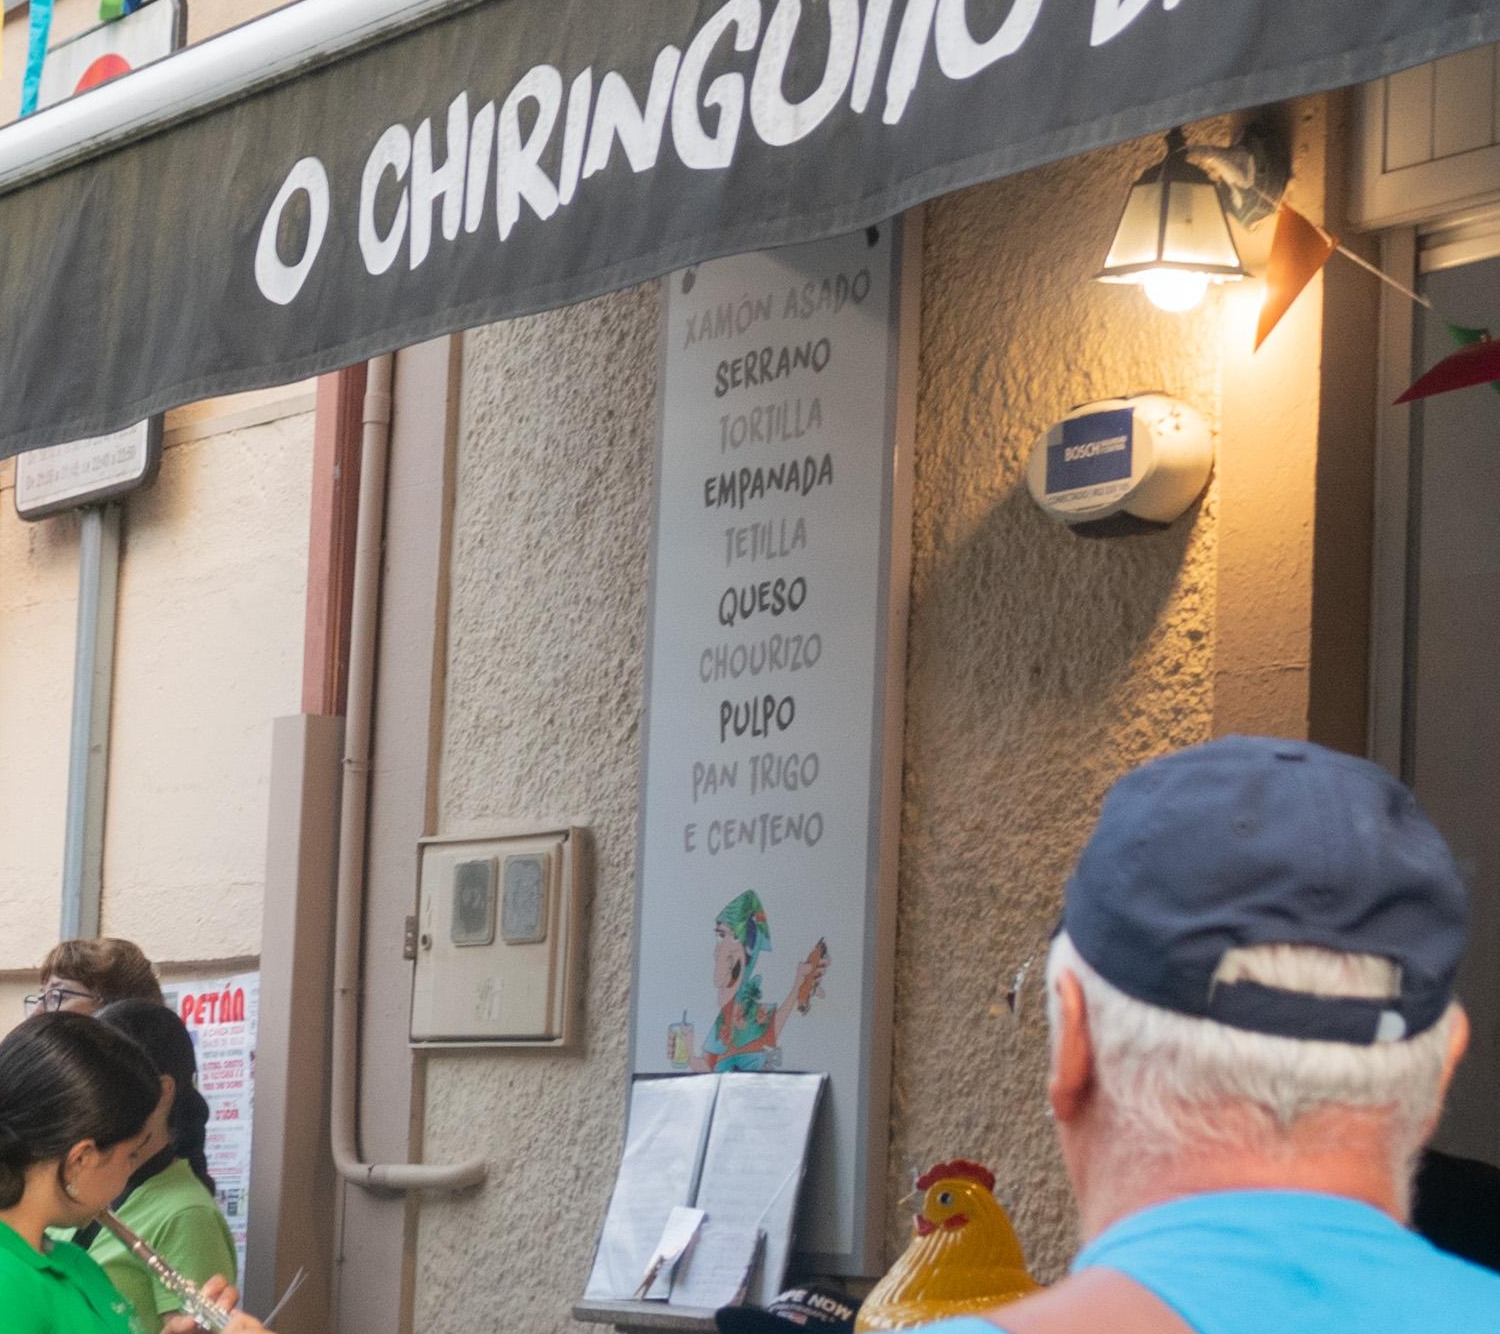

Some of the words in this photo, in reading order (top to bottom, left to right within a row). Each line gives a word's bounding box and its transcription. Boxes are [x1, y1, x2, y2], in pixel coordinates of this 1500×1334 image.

[255, 155, 330, 305] O
[684, 291, 772, 351] XAMÓN
[783, 267, 872, 321] ASADO
[715, 337, 831, 398] SERRANO
[719, 397, 823, 454] TORTILLA
[704, 453, 834, 509] EMPANADA
[725, 516, 807, 567] TETILLA
[718, 577, 807, 627] QUESO
[700, 633, 822, 683] CHOURIZO
[720, 695, 796, 744] PULPO
[692, 761, 738, 804] PAN
[750, 752, 820, 795] TRIGO
[684, 823, 697, 853] E
[707, 812, 824, 856] CENTENO
[181, 982, 245, 1027] PETÁN
